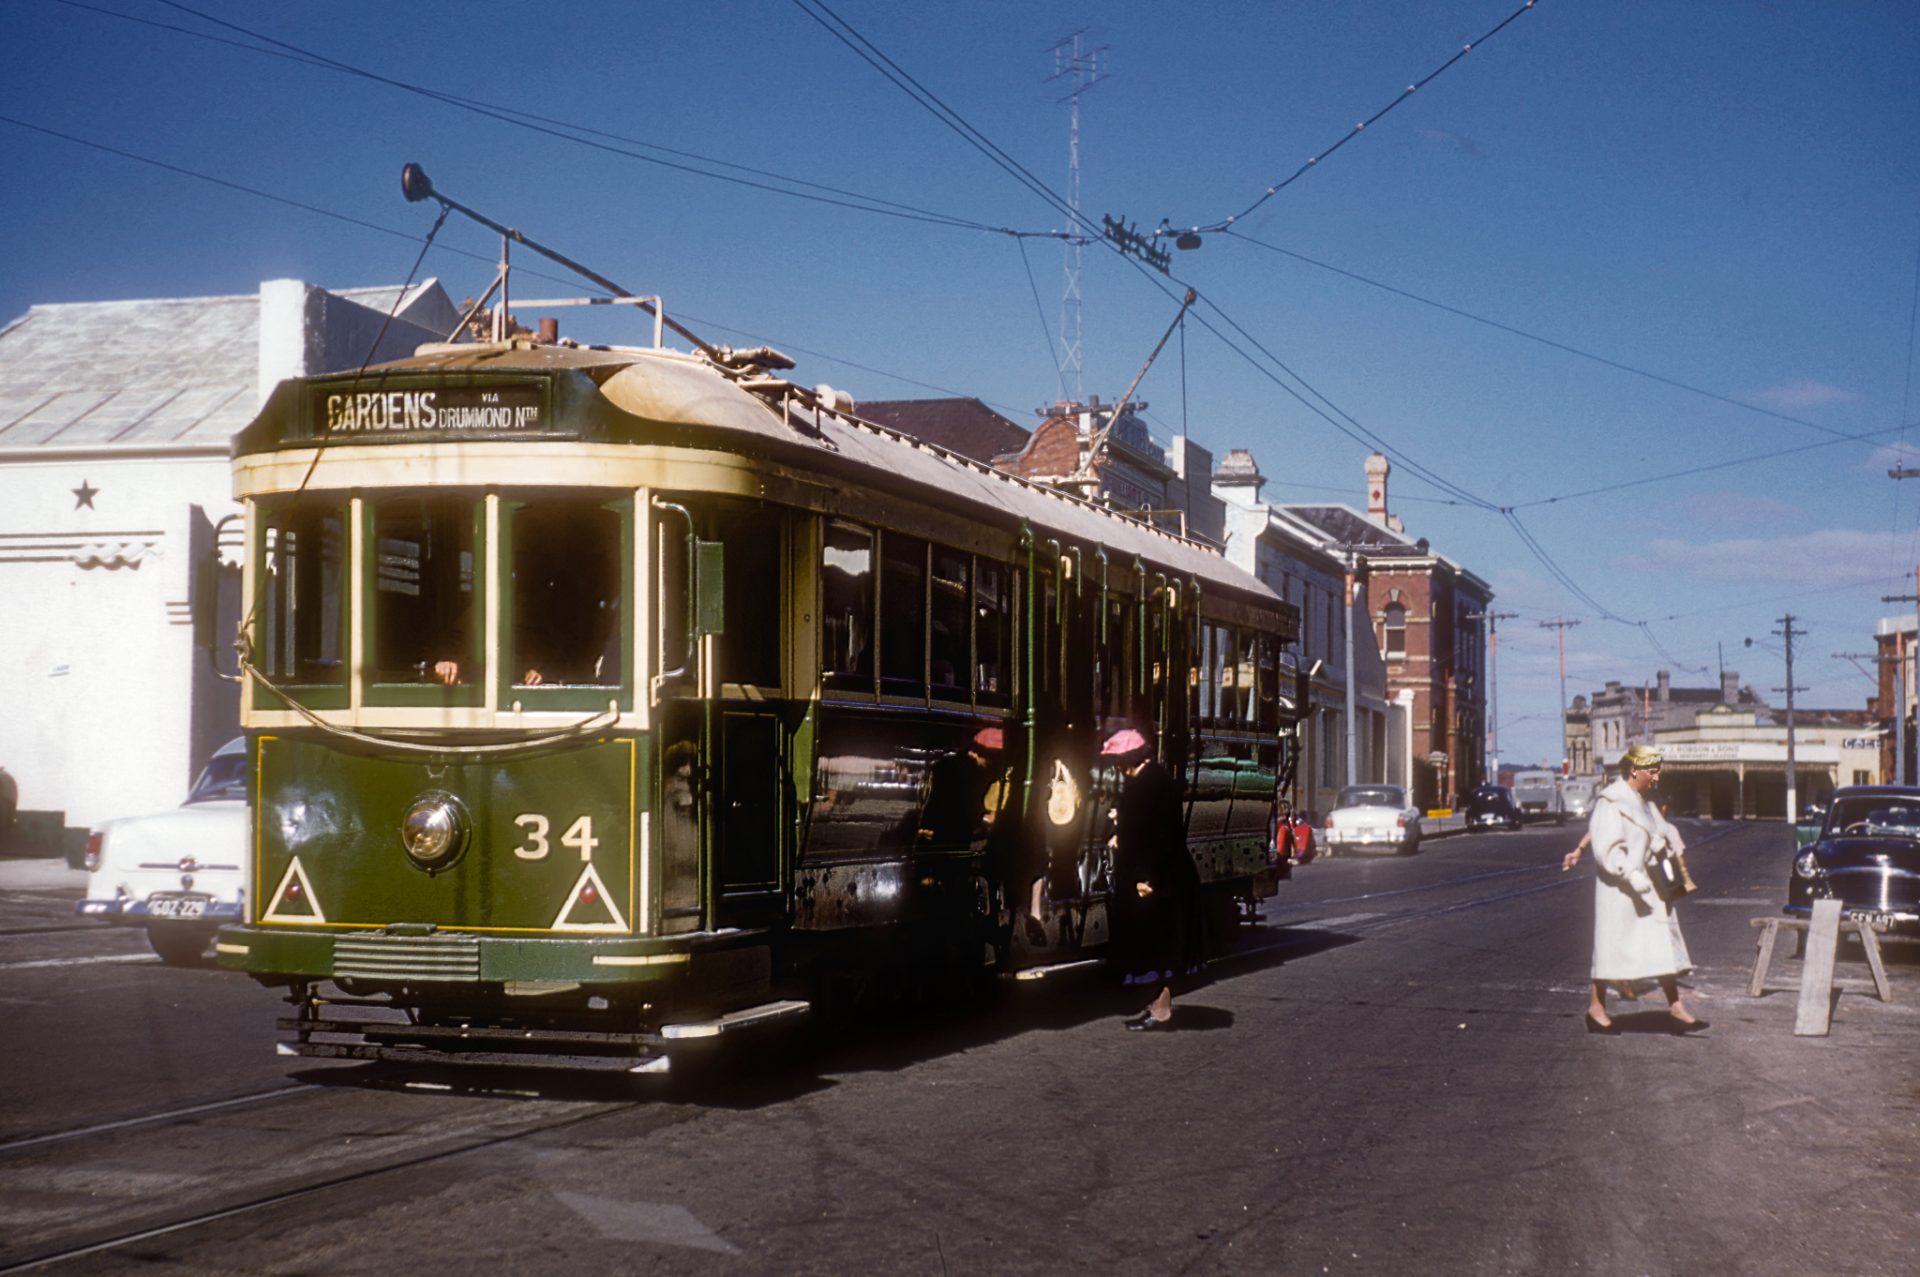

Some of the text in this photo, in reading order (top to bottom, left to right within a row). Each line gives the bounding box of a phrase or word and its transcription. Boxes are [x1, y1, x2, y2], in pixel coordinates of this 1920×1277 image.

[327, 392, 436, 431] GARDENS
[481, 392, 499, 403] VIA
[439, 407, 511, 429] DRUMMOND
[514, 813, 599, 861] 34
